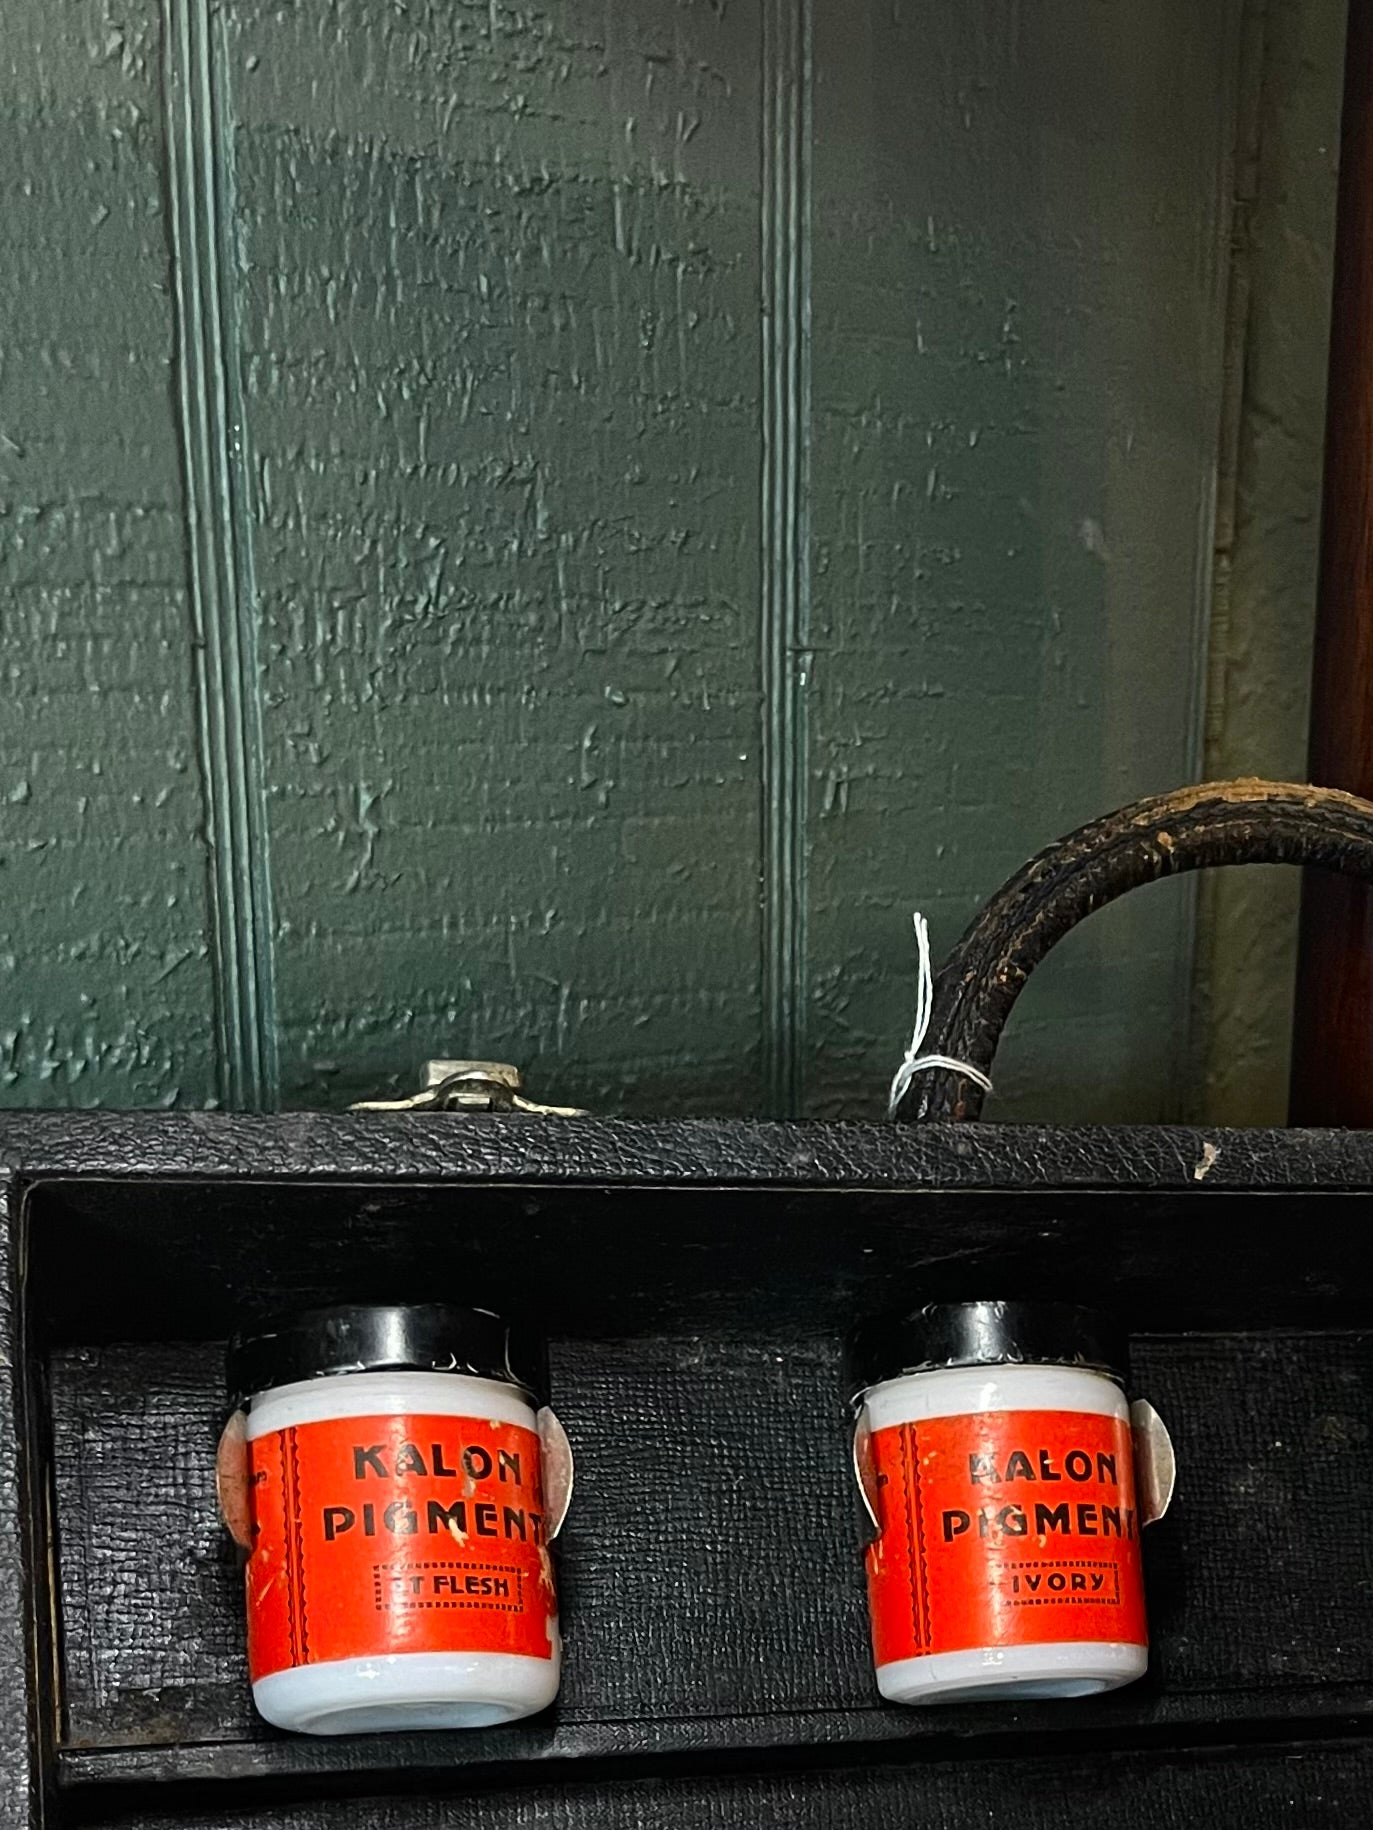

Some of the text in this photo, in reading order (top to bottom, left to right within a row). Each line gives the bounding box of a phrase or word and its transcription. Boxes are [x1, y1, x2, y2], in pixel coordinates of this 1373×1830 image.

[353, 1442, 522, 1486] KALON
[969, 1449, 1118, 1486] KALON
[322, 1501, 543, 1543] PIGMENT
[433, 1575, 509, 1597] FLESH
[1013, 1573, 1104, 1593] IVORY
